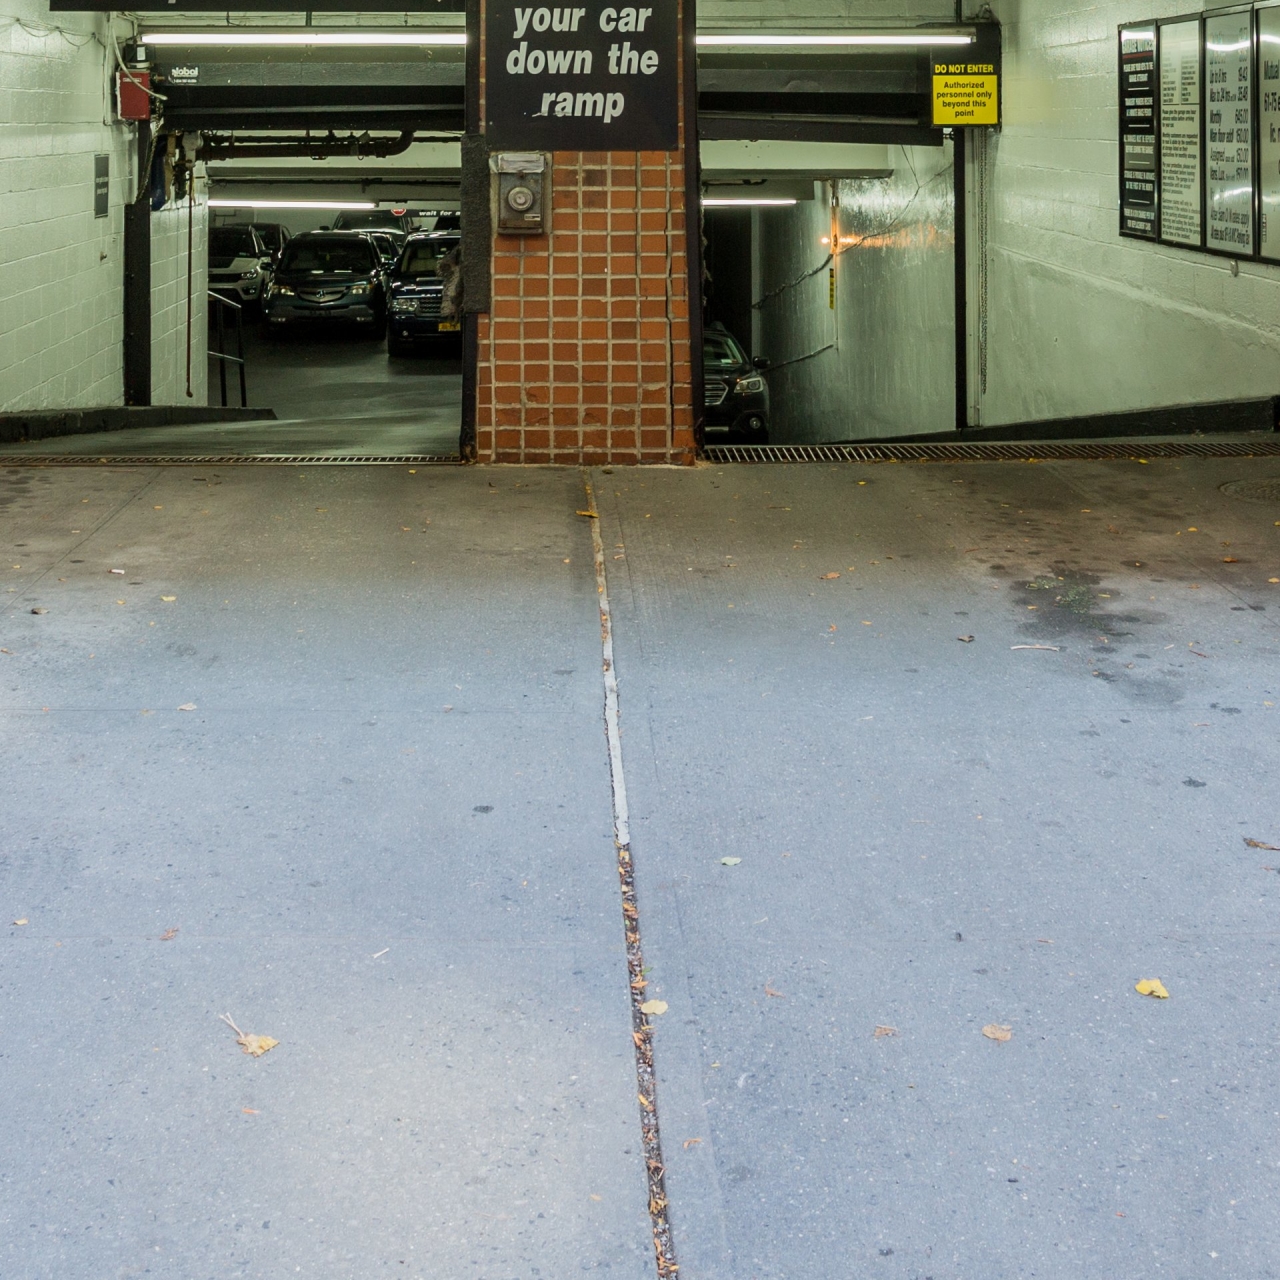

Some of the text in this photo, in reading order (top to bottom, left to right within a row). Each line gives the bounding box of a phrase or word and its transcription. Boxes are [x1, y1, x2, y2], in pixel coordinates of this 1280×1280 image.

[513, 7, 652, 39] your car
[506, 41, 659, 75] down the
[934, 64, 994, 73] DO NOT ENTER
[936, 90, 992, 100] personnel only
[541, 91, 625, 123] ramp
[942, 100, 970, 108] beyond
[954, 110, 974, 118] point
